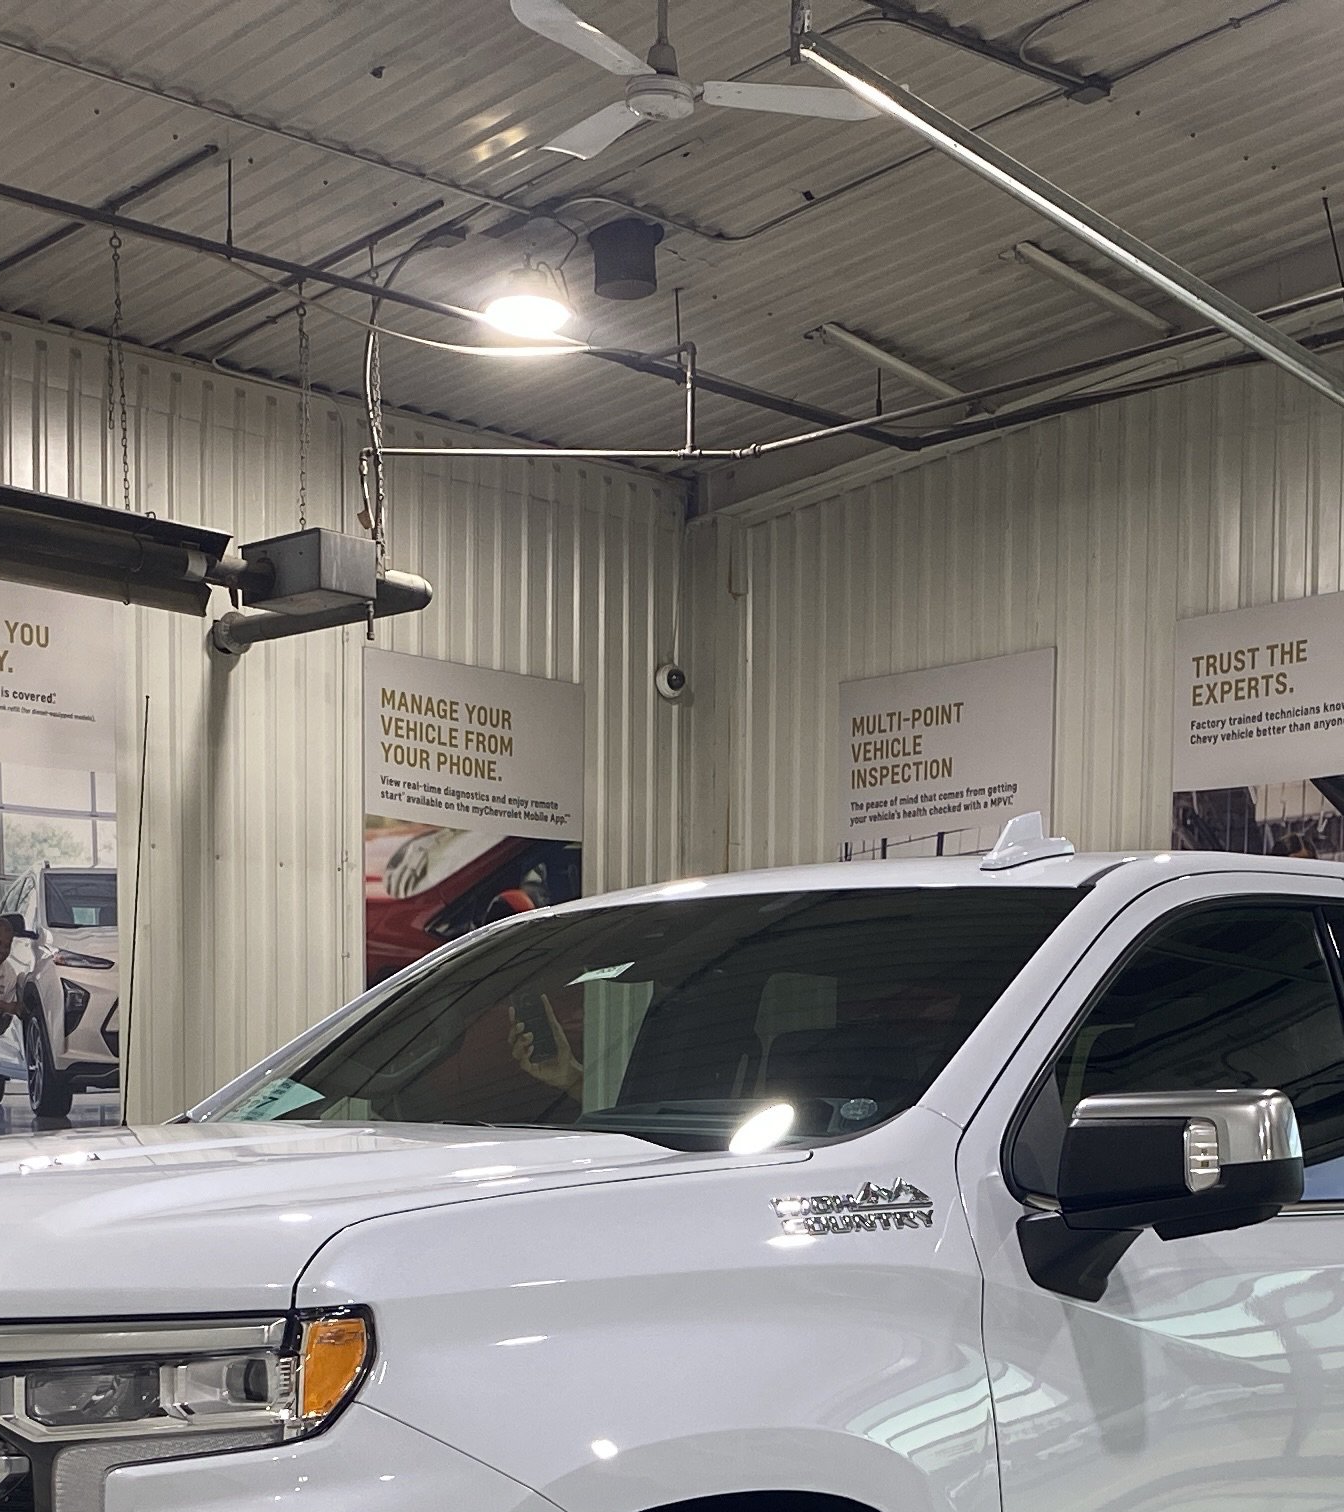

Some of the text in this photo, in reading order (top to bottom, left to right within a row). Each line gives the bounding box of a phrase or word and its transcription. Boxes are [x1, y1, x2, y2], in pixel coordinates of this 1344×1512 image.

[4, 620, 49, 648] YOU
[1191, 639, 1308, 677] TRUST THE
[0, 686, 10, 698] is
[1192, 673, 1294, 706] EXPERTS.
[381, 688, 512, 730] MANAGE YOUR
[852, 702, 964, 736] MULTI-POINT
[1190, 718, 1226, 731] Factory
[1228, 711, 1262, 726] trained
[1265, 706, 1320, 721] technicians
[380, 715, 513, 756] VEHICLE FROM
[850, 734, 922, 762] VEHICLE
[1190, 733, 1218, 745] Chevy
[1220, 728, 1254, 741] vehicle
[1256, 724, 1286, 736] better
[1288, 722, 1310, 732] than
[380, 742, 502, 781] YOUR PHONE.
[851, 758, 952, 788] INSPECTION
[379, 775, 558, 809] View real-time diagnostics and enjoy remote
[406, 794, 442, 806] available
[444, 799, 455, 808] on
[456, 799, 470, 810] the
[471, 802, 522, 816] myChevrolet
[523, 808, 548, 820] Mobile
[850, 783, 1018, 813] The peace of mind that comes from getting
[849, 815, 867, 827] your
[868, 809, 901, 822] vehicle's
[902, 805, 927, 818] health
[928, 801, 962, 815] checked
[963, 799, 981, 811] with
[983, 800, 988, 808] a
